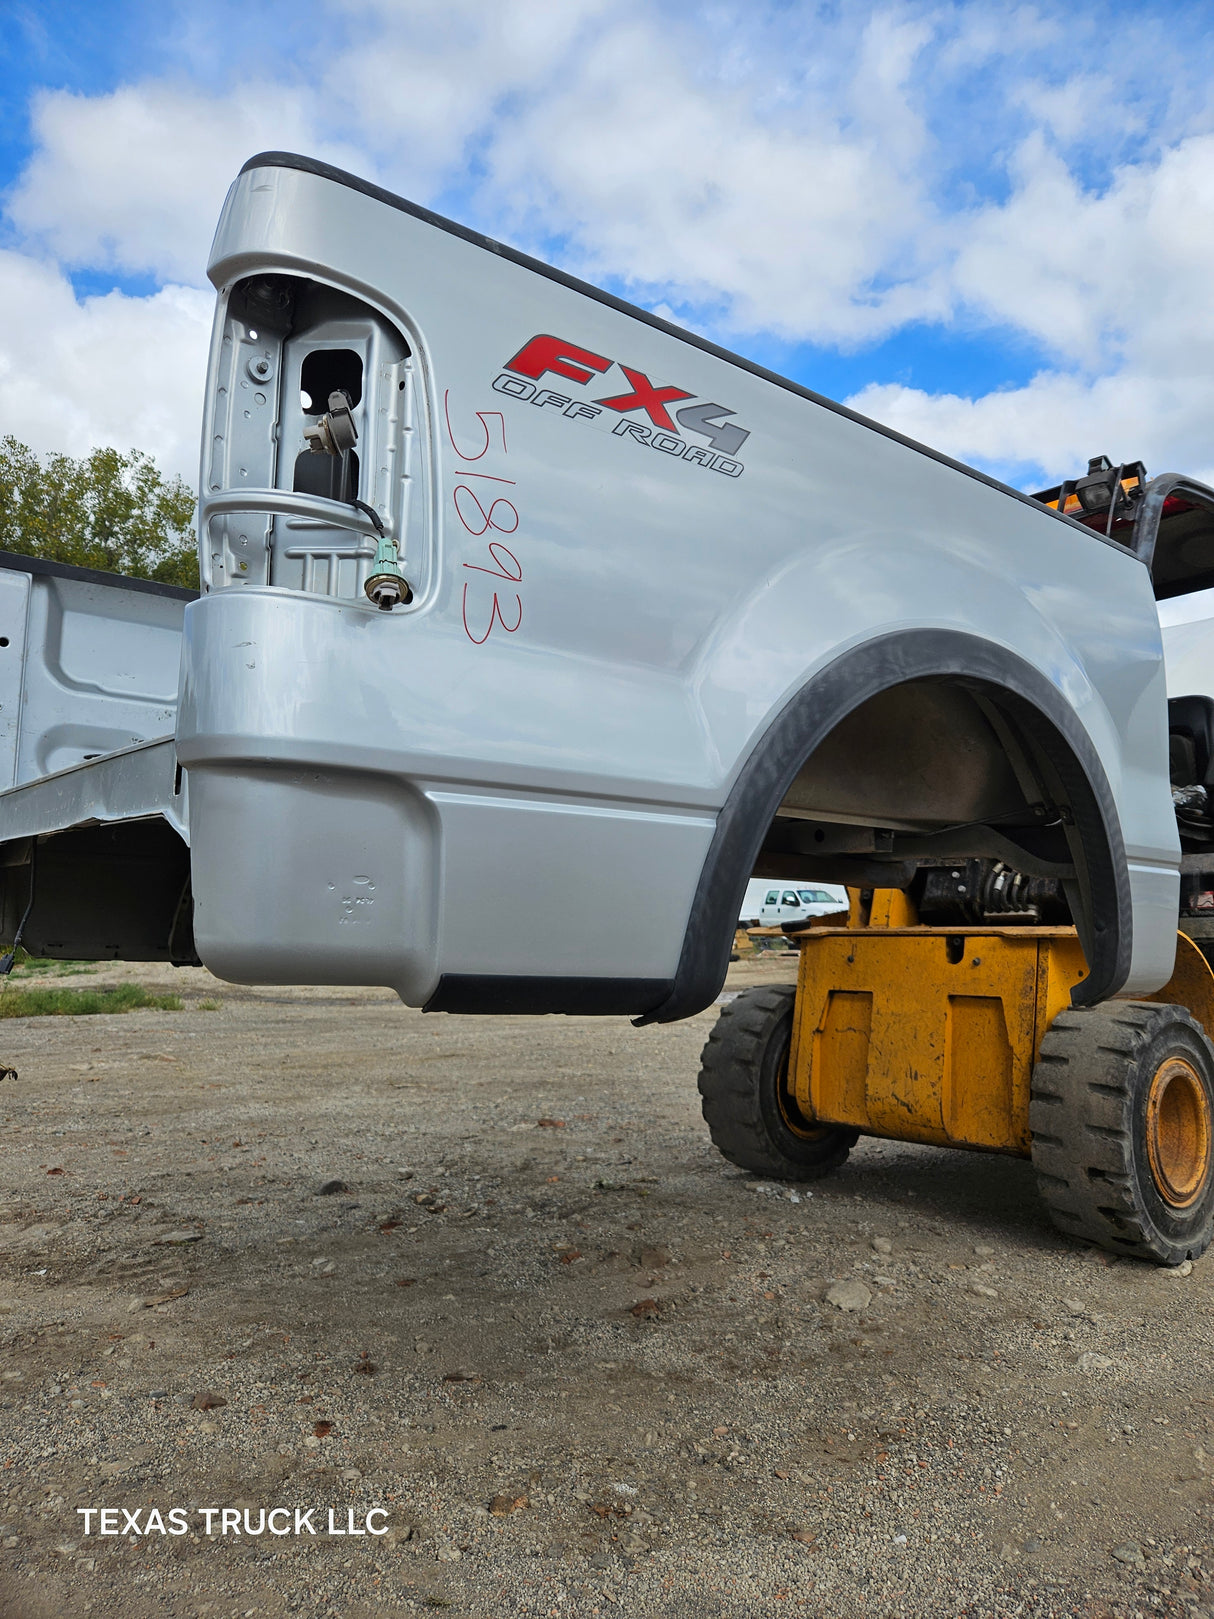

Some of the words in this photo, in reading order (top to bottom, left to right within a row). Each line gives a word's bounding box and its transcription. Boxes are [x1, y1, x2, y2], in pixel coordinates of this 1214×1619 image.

[492, 373, 602, 420] OFF
[612, 418, 745, 478] ROAD
[503, 334, 751, 456] FX4
[445, 389, 522, 644] 51893
